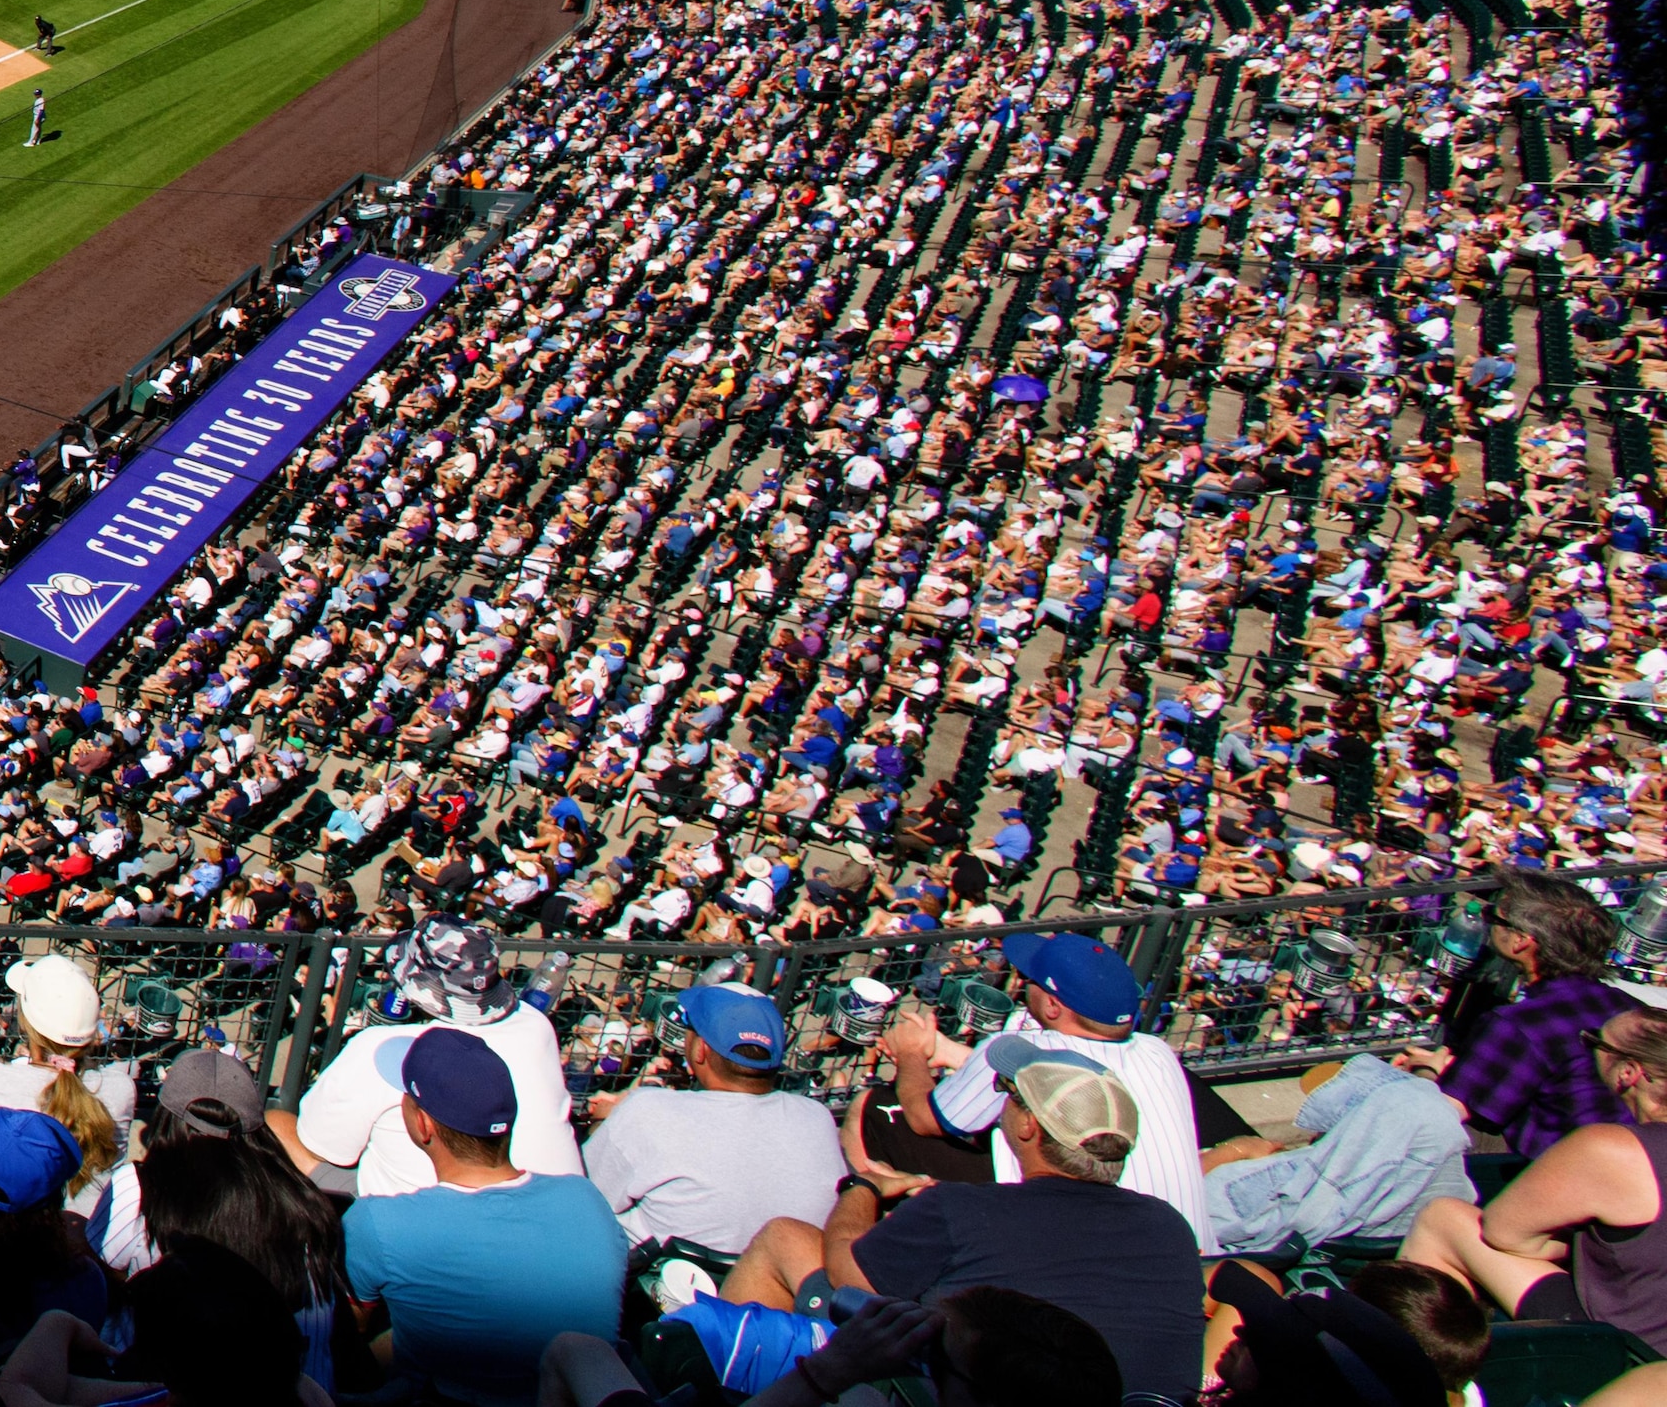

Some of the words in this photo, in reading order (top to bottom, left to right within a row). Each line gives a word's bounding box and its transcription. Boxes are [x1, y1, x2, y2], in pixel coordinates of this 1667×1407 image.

[274, 317, 377, 383] YEARS
[242, 378, 313, 414] 30
[86, 407, 285, 567] CELEBRATING
